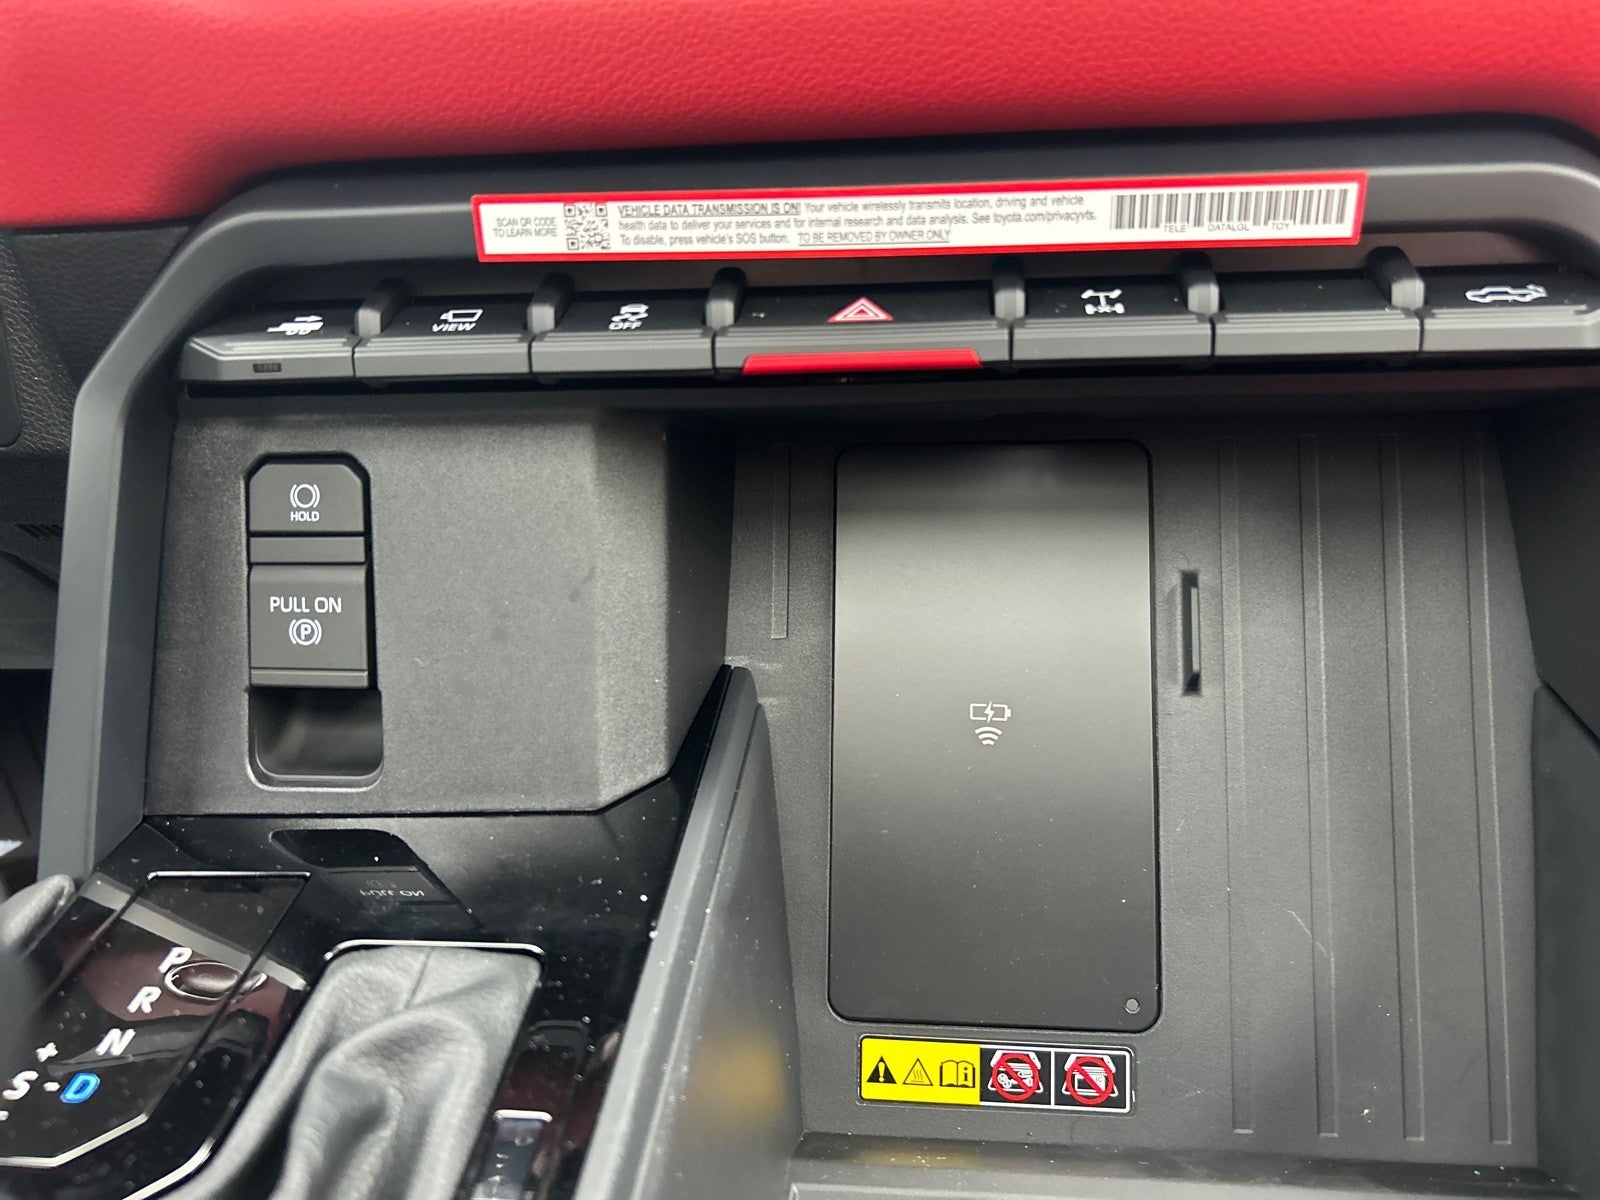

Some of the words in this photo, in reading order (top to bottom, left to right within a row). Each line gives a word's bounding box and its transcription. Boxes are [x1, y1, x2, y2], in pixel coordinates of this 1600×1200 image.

[618, 204, 660, 216] VEHICLE
[663, 204, 688, 216] DATA
[691, 203, 768, 216] TRANSMISSION
[771, 202, 780, 214] IS
[804, 203, 824, 213] Your
[828, 202, 858, 212] vehicle
[862, 200, 906, 214] wirelessly
[909, 199, 951, 210] transmits
[996, 197, 1026, 210] driving
[1030, 196, 1048, 206] and
[1051, 195, 1084, 206] vehicle
[496, 218, 518, 228] SCAN
[534, 216, 557, 227] CODE
[619, 220, 645, 230] health
[648, 220, 667, 230] data
[670, 220, 679, 230] to
[682, 218, 710, 230] deliver
[714, 220, 732, 232] your
[736, 218, 771, 229] services
[775, 218, 790, 228] and
[794, 218, 805, 228] for
[808, 217, 841, 228] internal
[844, 216, 883, 227] research
[887, 216, 904, 226] and
[906, 215, 926, 225] data
[972, 212, 990, 224] See
[1164, 225, 1186, 234] TELE
[1271, 222, 1290, 231] TOY
[494, 228, 504, 238] TO
[506, 228, 532, 238] LEARN
[534, 228, 558, 237] MORE
[620, 234, 631, 246] To
[670, 234, 693, 246] press
[696, 233, 734, 245] vehicle's
[736, 232, 756, 244] SOS
[798, 232, 810, 243] TO
[813, 232, 824, 242] BE
[827, 231, 872, 242] REMOVED
[875, 230, 886, 242] BY
[889, 230, 924, 241] OWNER
[926, 229, 950, 240] ONLY
[432, 323, 476, 332] VIEW
[608, 321, 642, 330] OFF
[290, 511, 320, 522] HOLD
[270, 596, 310, 613] PULL
[314, 596, 342, 613] ON
[158, 946, 192, 973] P
[126, 986, 162, 1014] R
[95, 1028, 136, 1056] N
[2, 1070, 39, 1100] S
[60, 1072, 100, 1104] D
